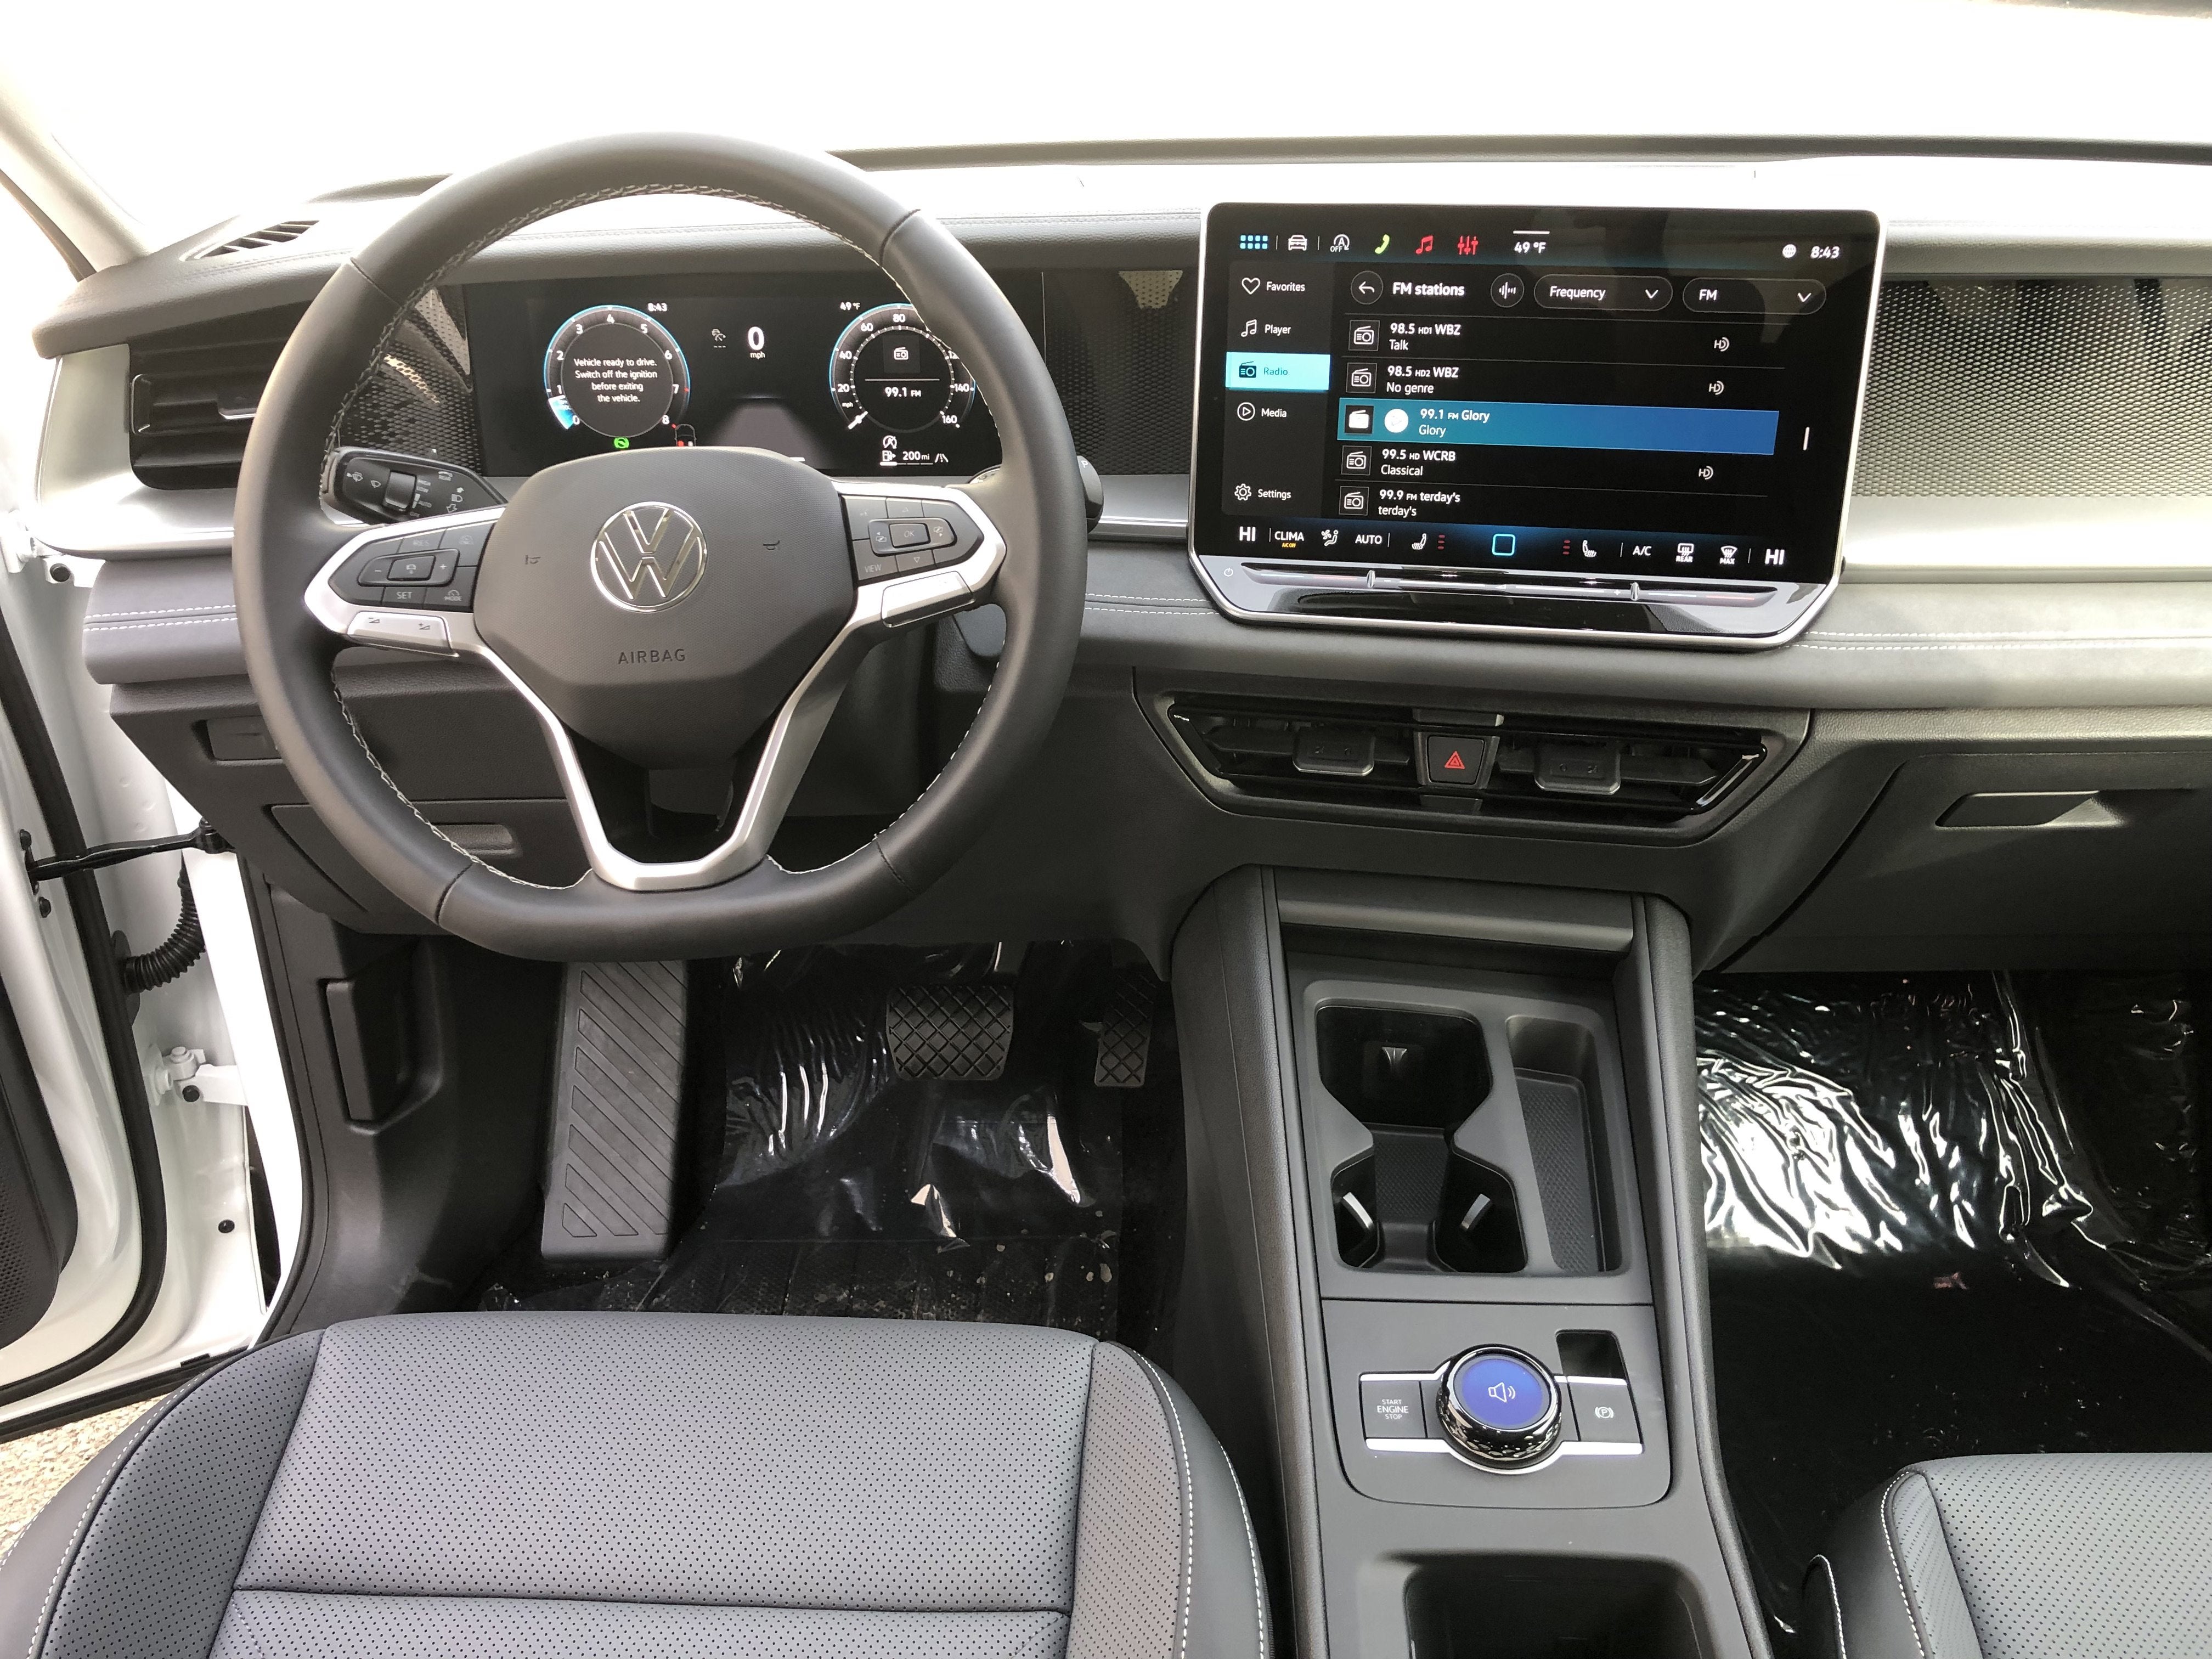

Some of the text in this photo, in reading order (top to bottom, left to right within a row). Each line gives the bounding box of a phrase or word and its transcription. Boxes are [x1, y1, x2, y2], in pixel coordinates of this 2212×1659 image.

[1514, 241, 1531, 253] 49
[1810, 246, 1840, 259] 8:43
[1266, 281, 1305, 292] Favorites
[1392, 283, 1465, 296] FM stations
[1550, 285, 1606, 301] Frequency
[1699, 289, 1718, 301] FM
[647, 302, 668, 312] 8:43
[839, 301, 852, 311] 49
[606, 314, 615, 324] 4
[893, 313, 906, 323] 80
[576, 324, 583, 334] 3
[640, 324, 648, 334] 5
[859, 321, 874, 332] 60
[1265, 324, 1291, 336] Player
[1390, 322, 1462, 336] 98.5 HD1 WBZ
[748, 326, 765, 351] 0
[1389, 338, 1409, 351] Talk
[556, 351, 564, 360] 2
[664, 350, 672, 360] 6
[750, 351, 765, 360] mph
[839, 350, 852, 360] 40
[573, 358, 602, 366] Vehicle
[603, 358, 624, 368] ready
[636, 358, 657, 366] drive.
[574, 369, 658, 380] Switch off the ignition
[1263, 367, 1288, 376] Radio
[1387, 365, 1459, 378] 98.5 HD2 WBZ
[557, 385, 562, 394] 1
[591, 381, 644, 392] before exiting
[673, 384, 679, 394] 7
[837, 383, 850, 393] 20
[884, 386, 907, 397] 99.1
[955, 383, 969, 392] 140
[1386, 381, 1434, 396] No genre
[597, 393, 640, 402] the vehicle.
[1261, 408, 1287, 417] Media
[1420, 408, 1444, 420] 99.1
[1462, 409, 1490, 422] Glory
[573, 415, 580, 425] 0
[662, 415, 670, 425] 8
[941, 414, 958, 425] 160
[1419, 425, 1447, 436] Glory
[902, 451, 921, 460] 200
[1382, 448, 1407, 460] 99.5
[1423, 450, 1456, 461] WCRB
[1381, 464, 1423, 476] Classical
[1257, 489, 1291, 501] Settings
[1379, 489, 1404, 500] 99.9
[1419, 491, 1460, 505] terday's
[1378, 505, 1417, 518] terday's
[1239, 526, 1256, 541] HI
[1274, 531, 1305, 541] CLIMA
[1355, 534, 1383, 545] AUTO
[1632, 545, 1652, 556] A/C
[1764, 549, 1785, 566] HI
[865, 564, 882, 573] VIEW
[618, 648, 686, 665] AIRBAG
[1377, 1406, 1409, 1414] ENGINE
